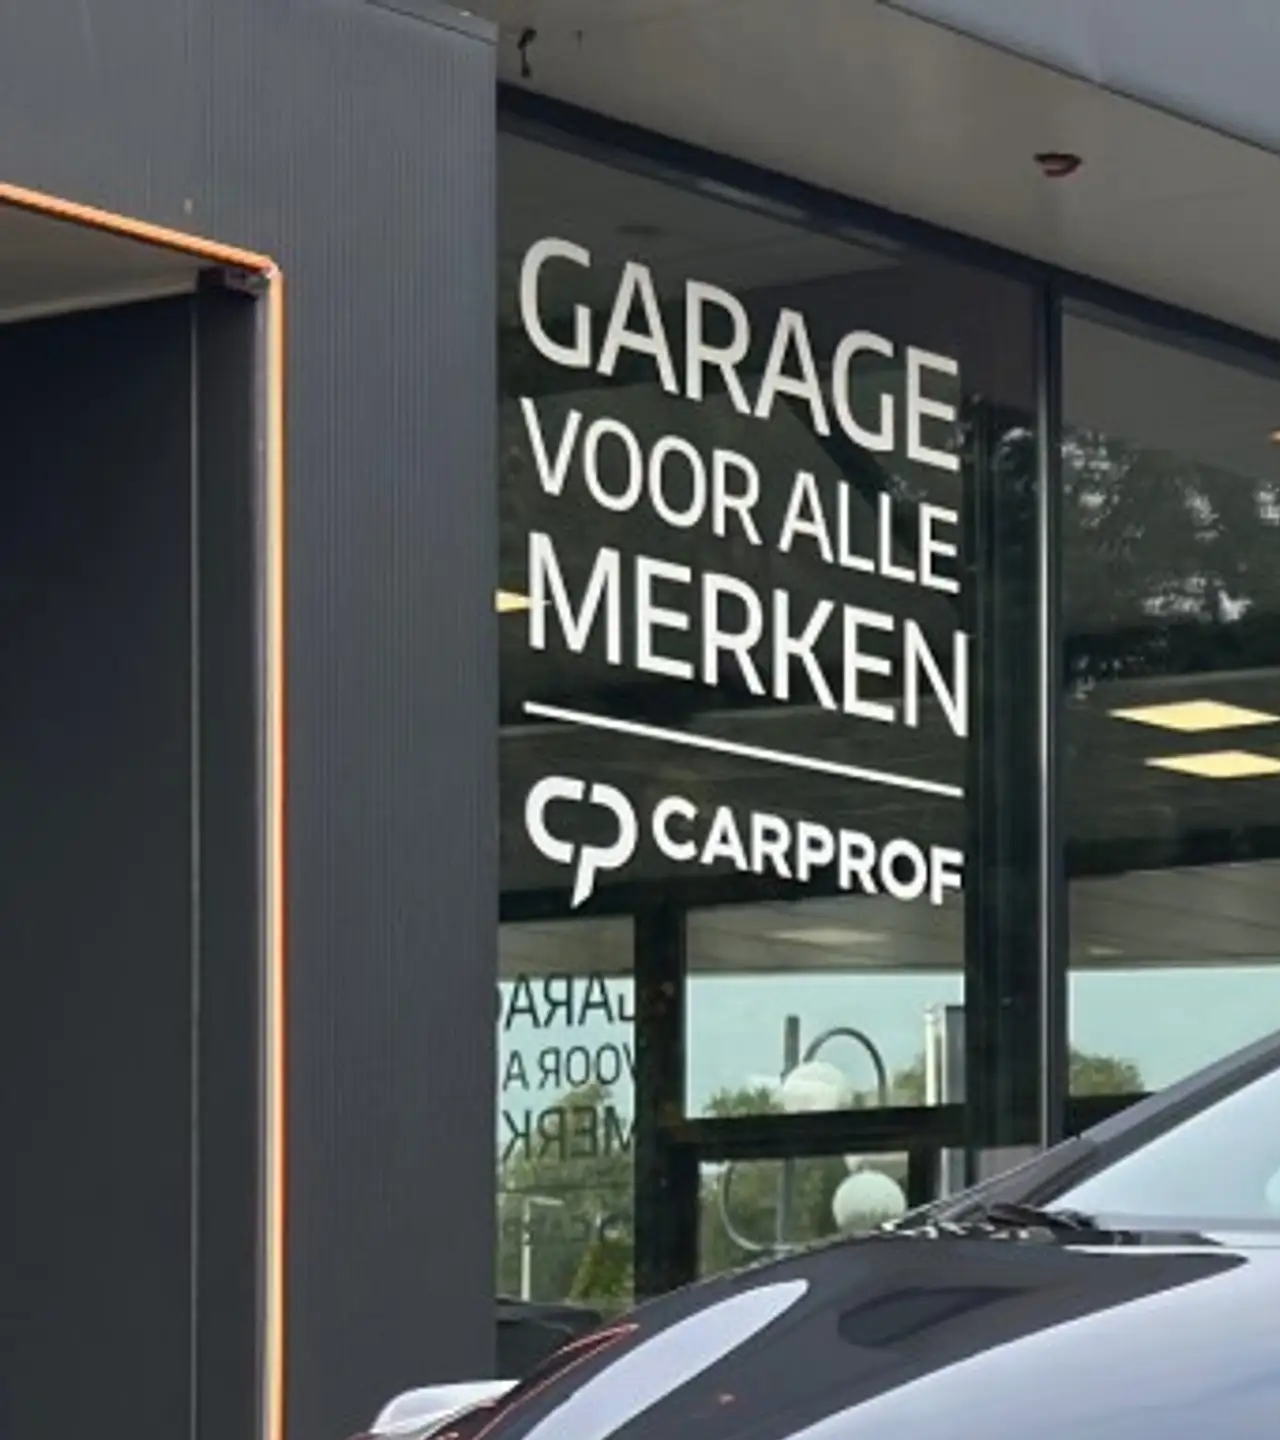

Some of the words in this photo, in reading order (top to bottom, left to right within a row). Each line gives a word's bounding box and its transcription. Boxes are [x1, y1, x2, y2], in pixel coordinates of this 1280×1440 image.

[519, 237, 961, 471] GARAGE
[520, 397, 763, 546] VOOR
[778, 471, 960, 594] ALLE
[528, 531, 969, 737] MERKEN
[651, 795, 964, 905] CARPROF
